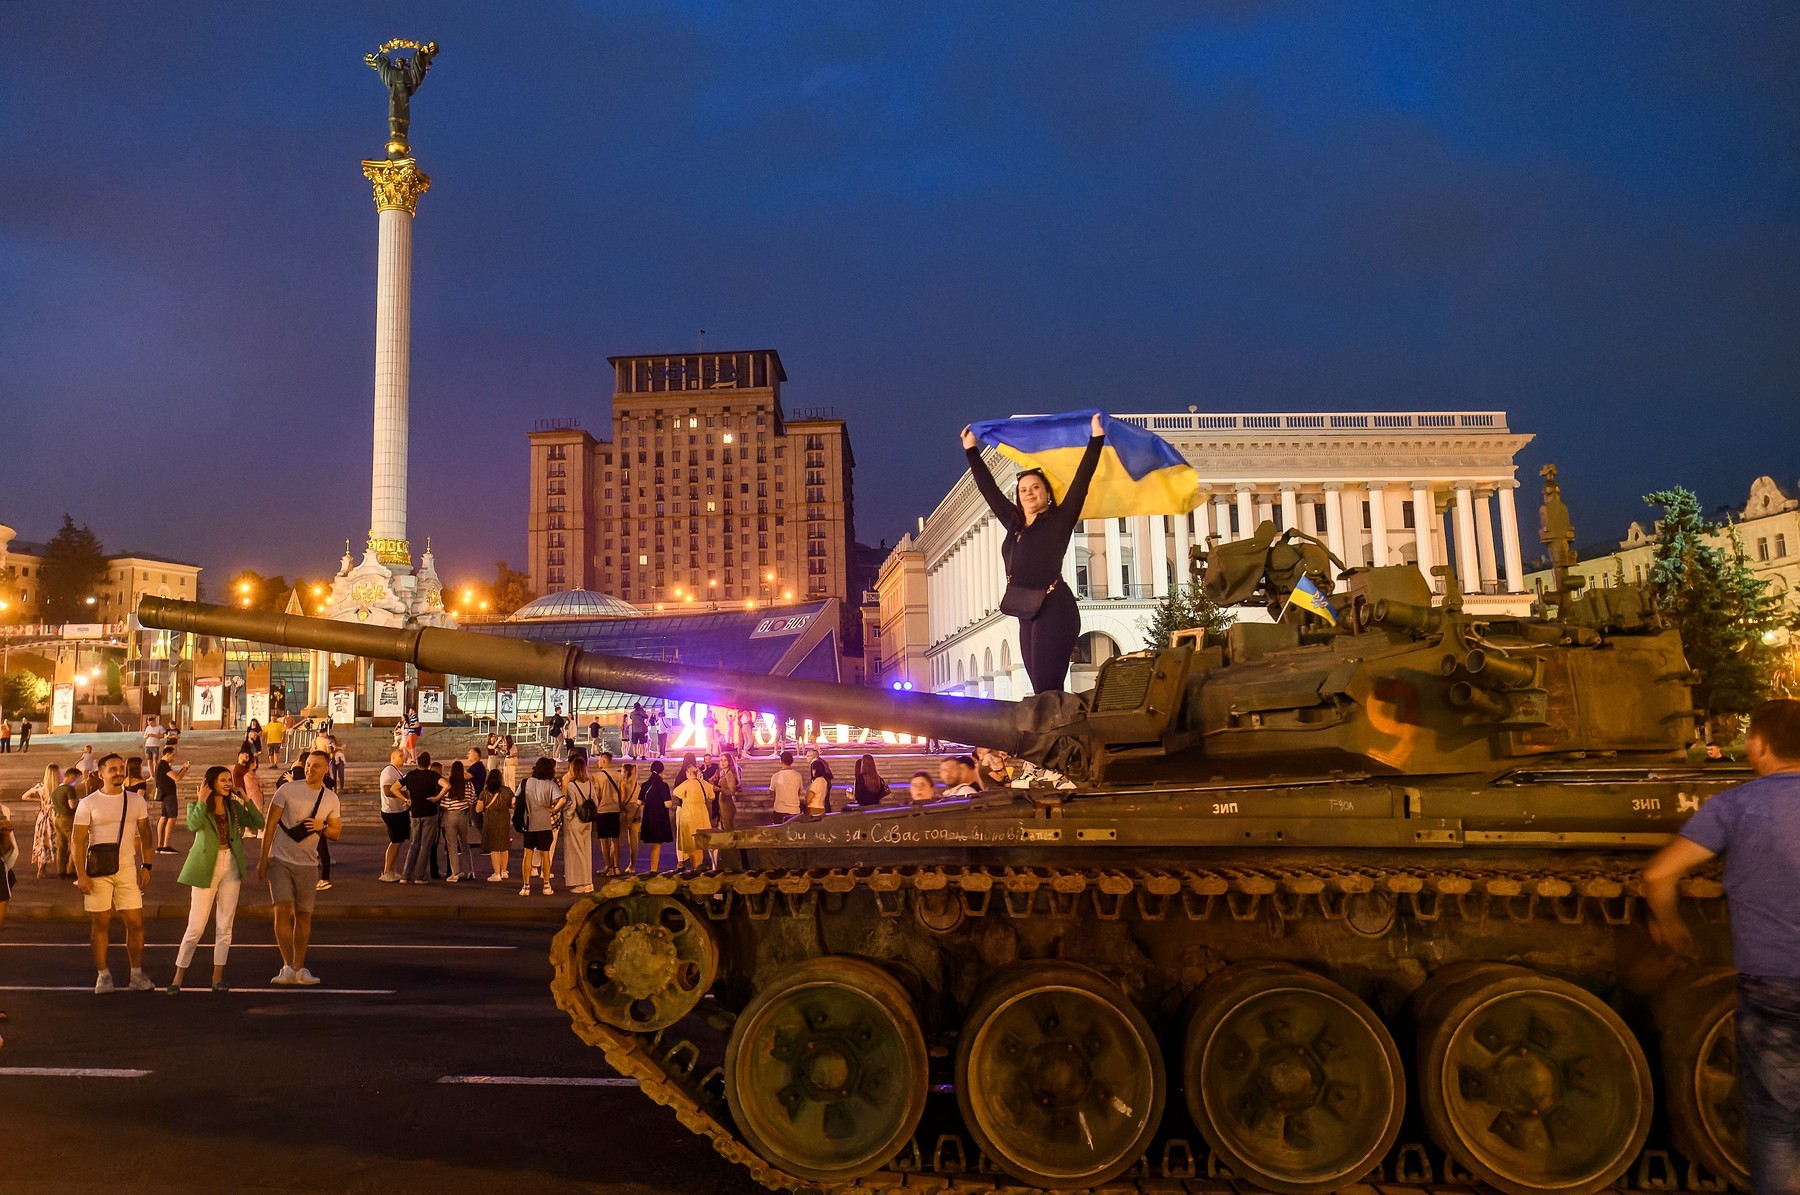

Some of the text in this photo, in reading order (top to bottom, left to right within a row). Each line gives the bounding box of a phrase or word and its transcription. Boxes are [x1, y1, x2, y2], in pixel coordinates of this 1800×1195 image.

[757, 615, 810, 633] GLOBUS
[1212, 802, 1239, 815] ЗИП
[1632, 798, 1661, 811] ЗИП
[843, 829, 861, 842] за
